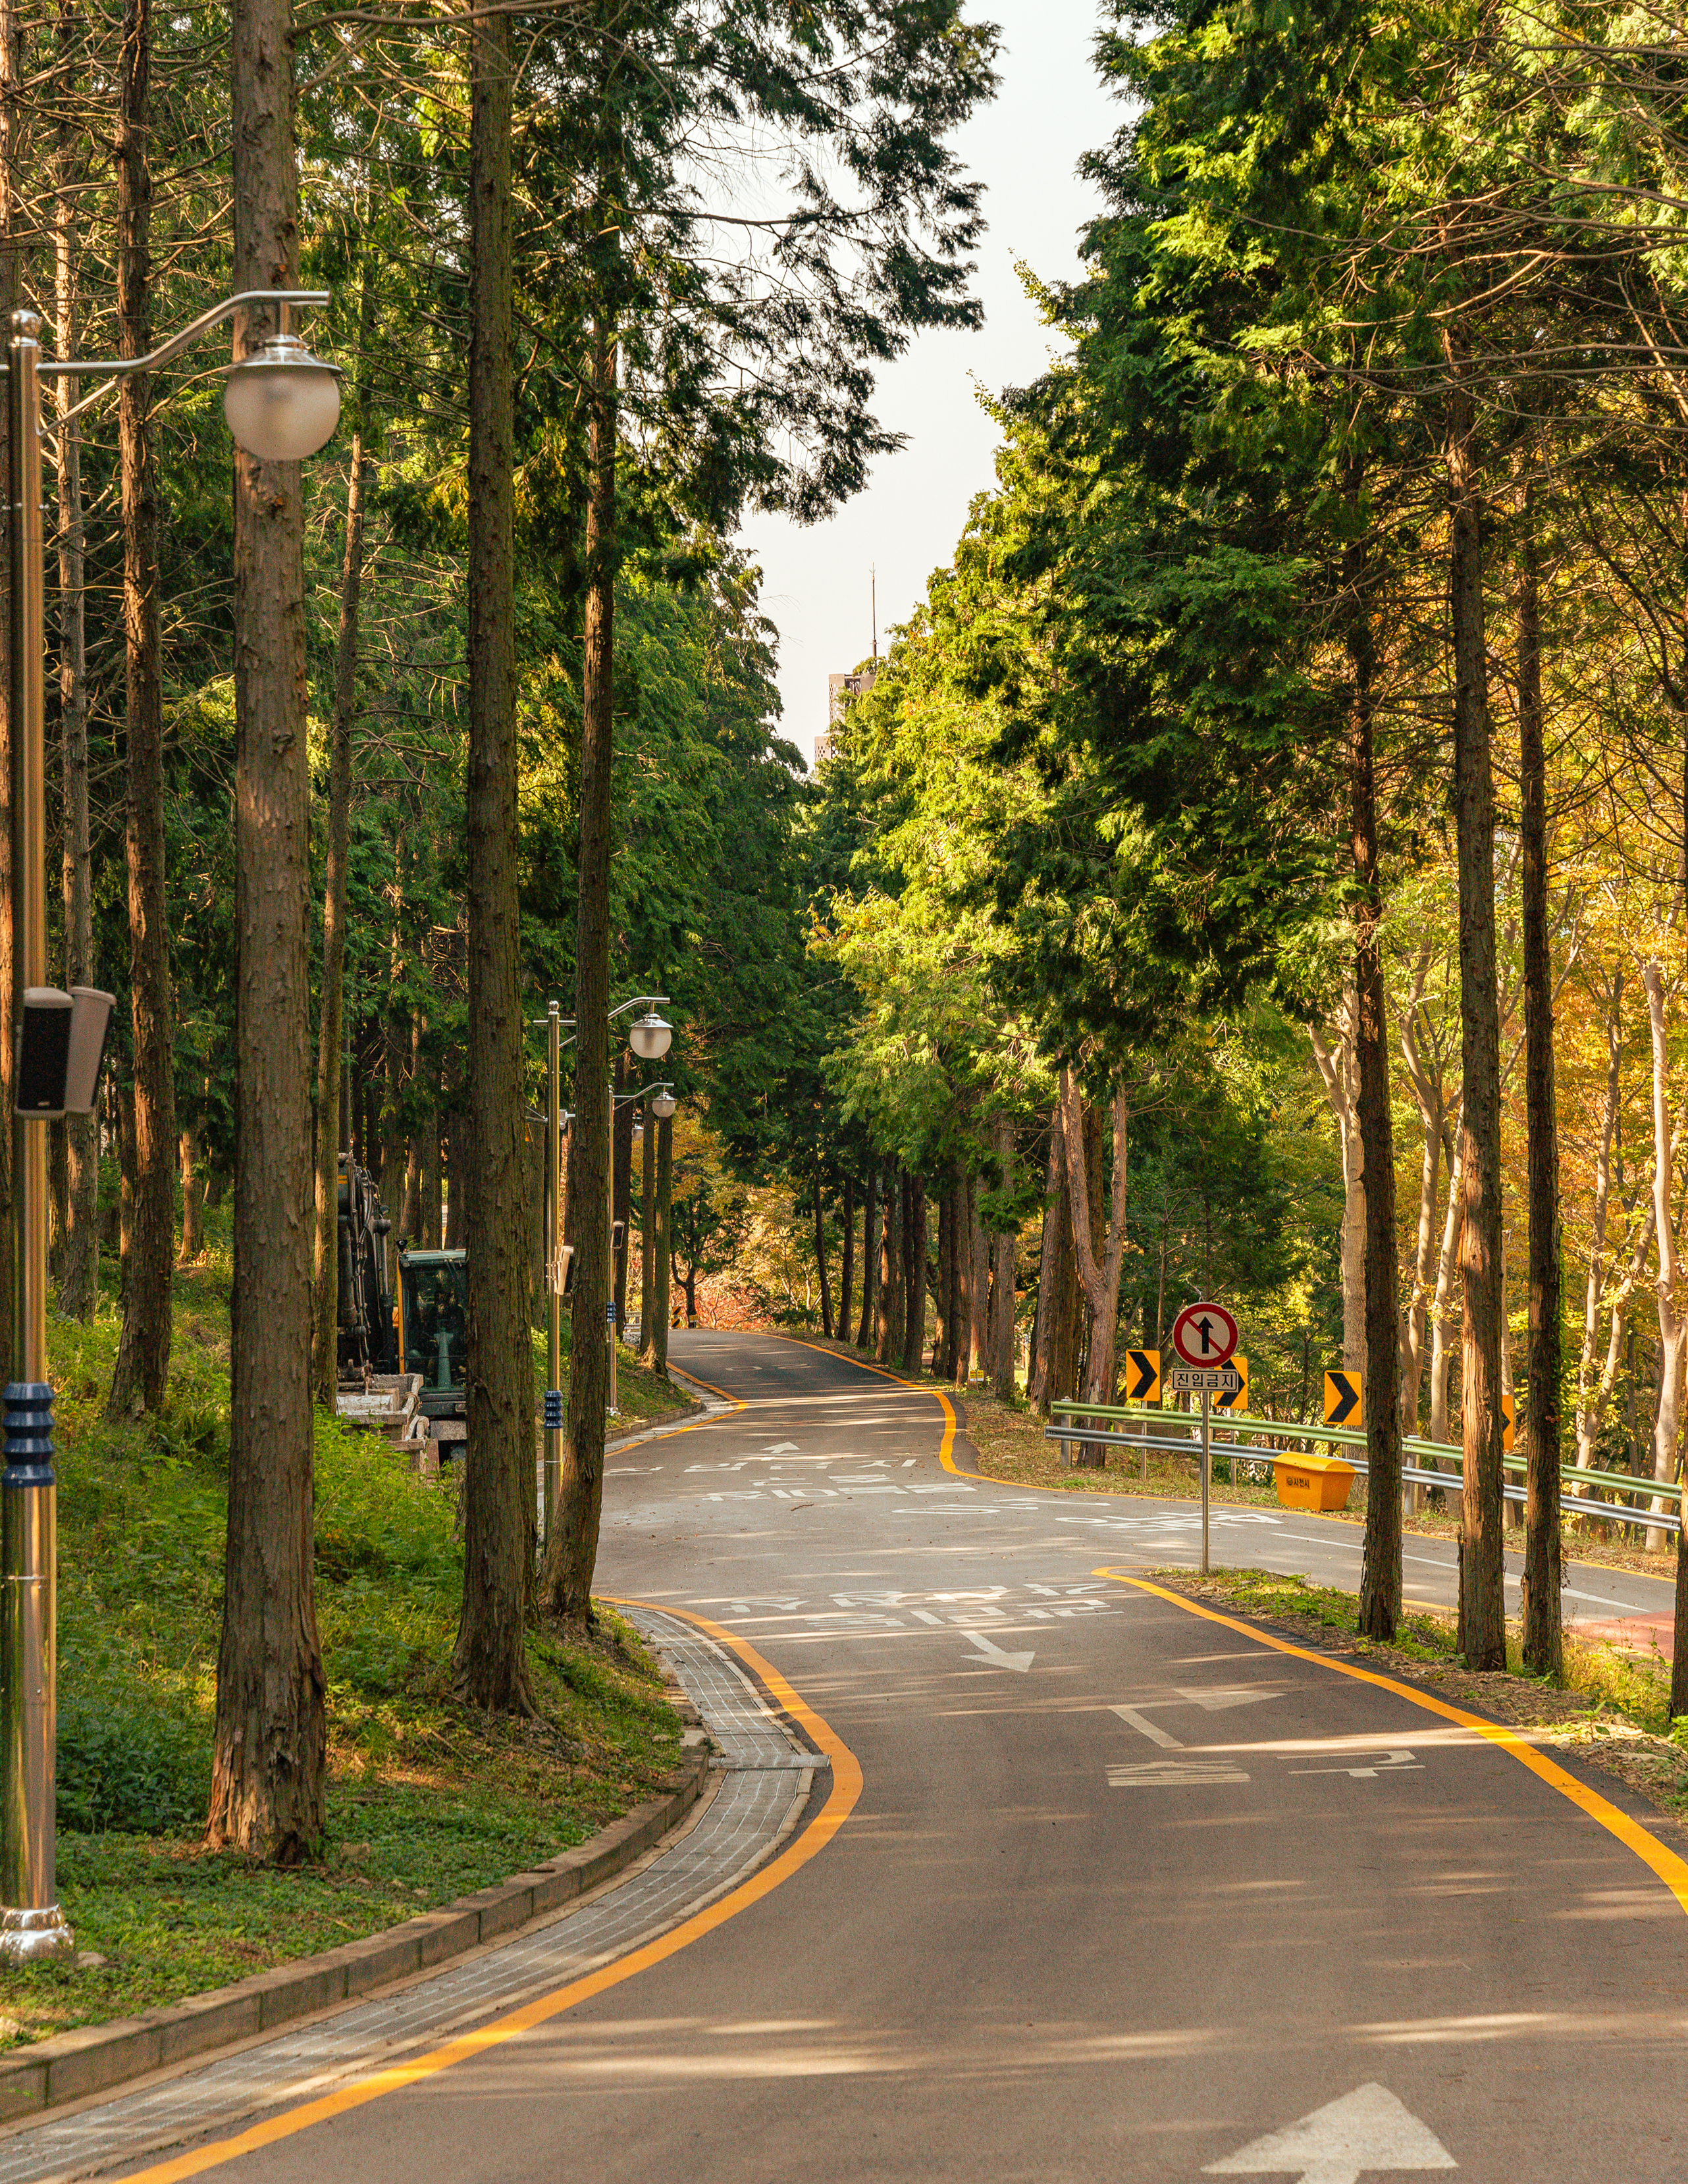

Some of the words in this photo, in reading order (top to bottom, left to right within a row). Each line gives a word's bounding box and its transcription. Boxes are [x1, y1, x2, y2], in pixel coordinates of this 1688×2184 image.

[1176, 1372, 1236, 1389] 진입금지
[603, 1459, 916, 1476] 진입금지
[749, 1474, 895, 1486] 출구
[1294, 1478, 1309, 1488] 사천시
[702, 1482, 978, 1501] 물놀이장
[722, 1583, 1126, 1613] 각산정상
[804, 1599, 1124, 1630] 관리동
[1105, 1750, 1425, 1786] 출구
